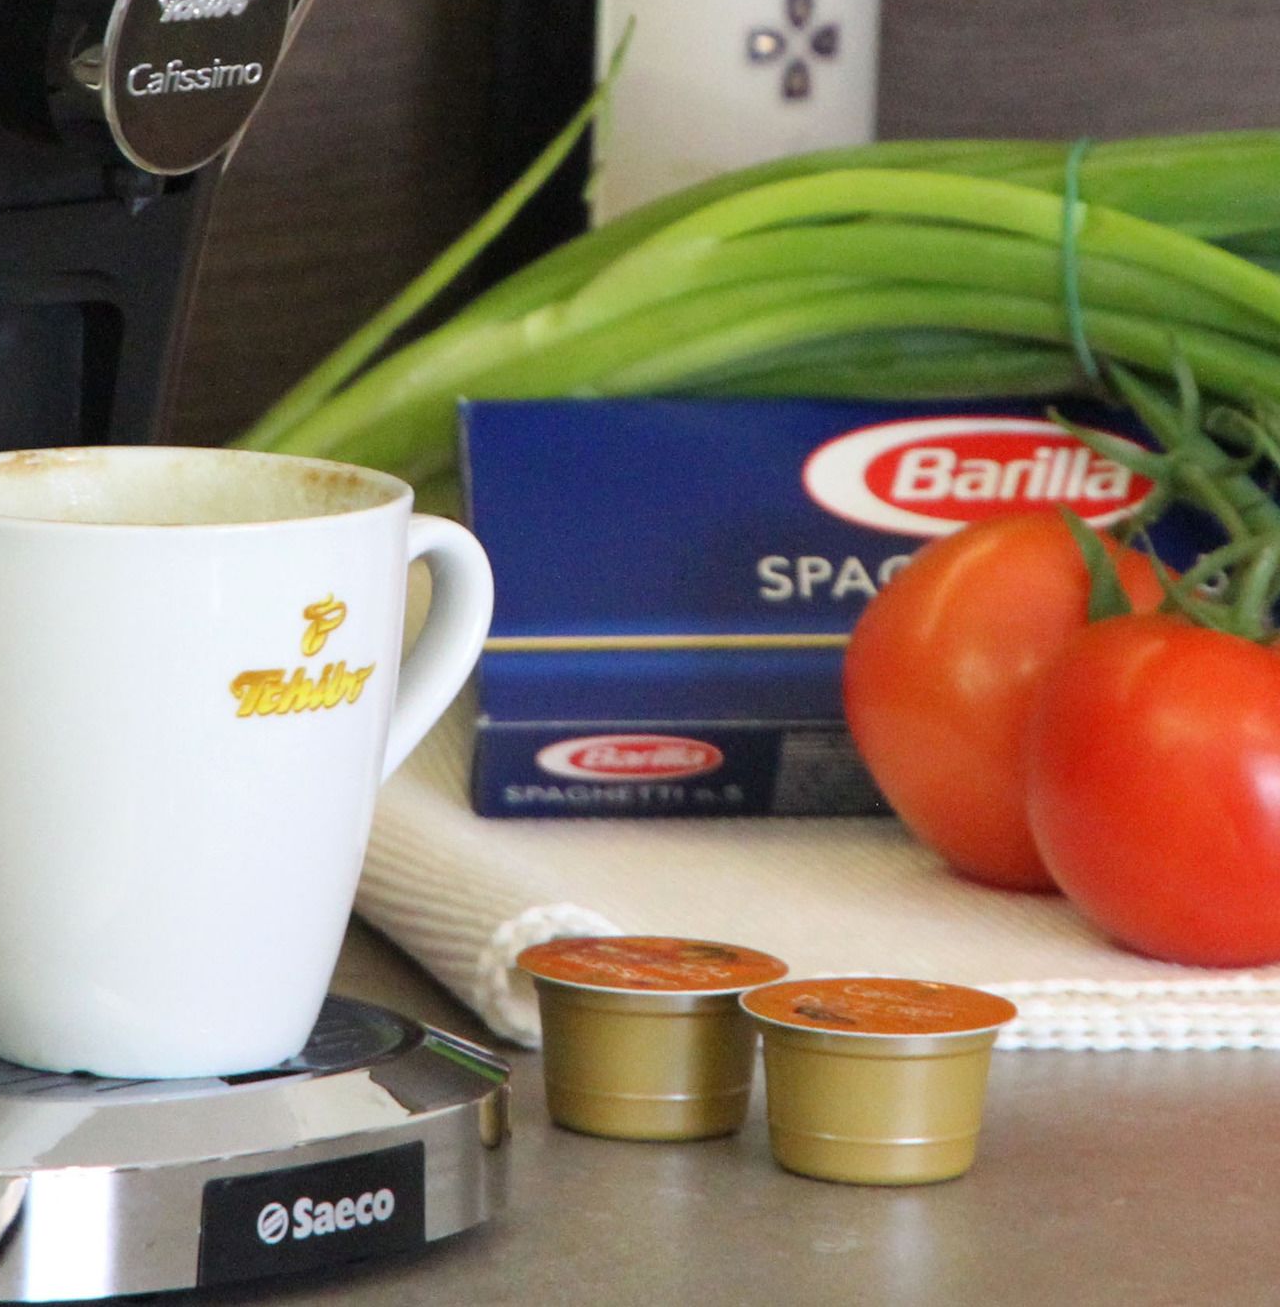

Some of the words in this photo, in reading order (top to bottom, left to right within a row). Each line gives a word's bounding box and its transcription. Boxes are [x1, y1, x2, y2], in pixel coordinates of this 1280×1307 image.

[127, 58, 263, 96] Cafissimo
[891, 446, 1132, 501] Barilla
[230, 660, 376, 718] Tchibo
[292, 1188, 395, 1239] Saeco
